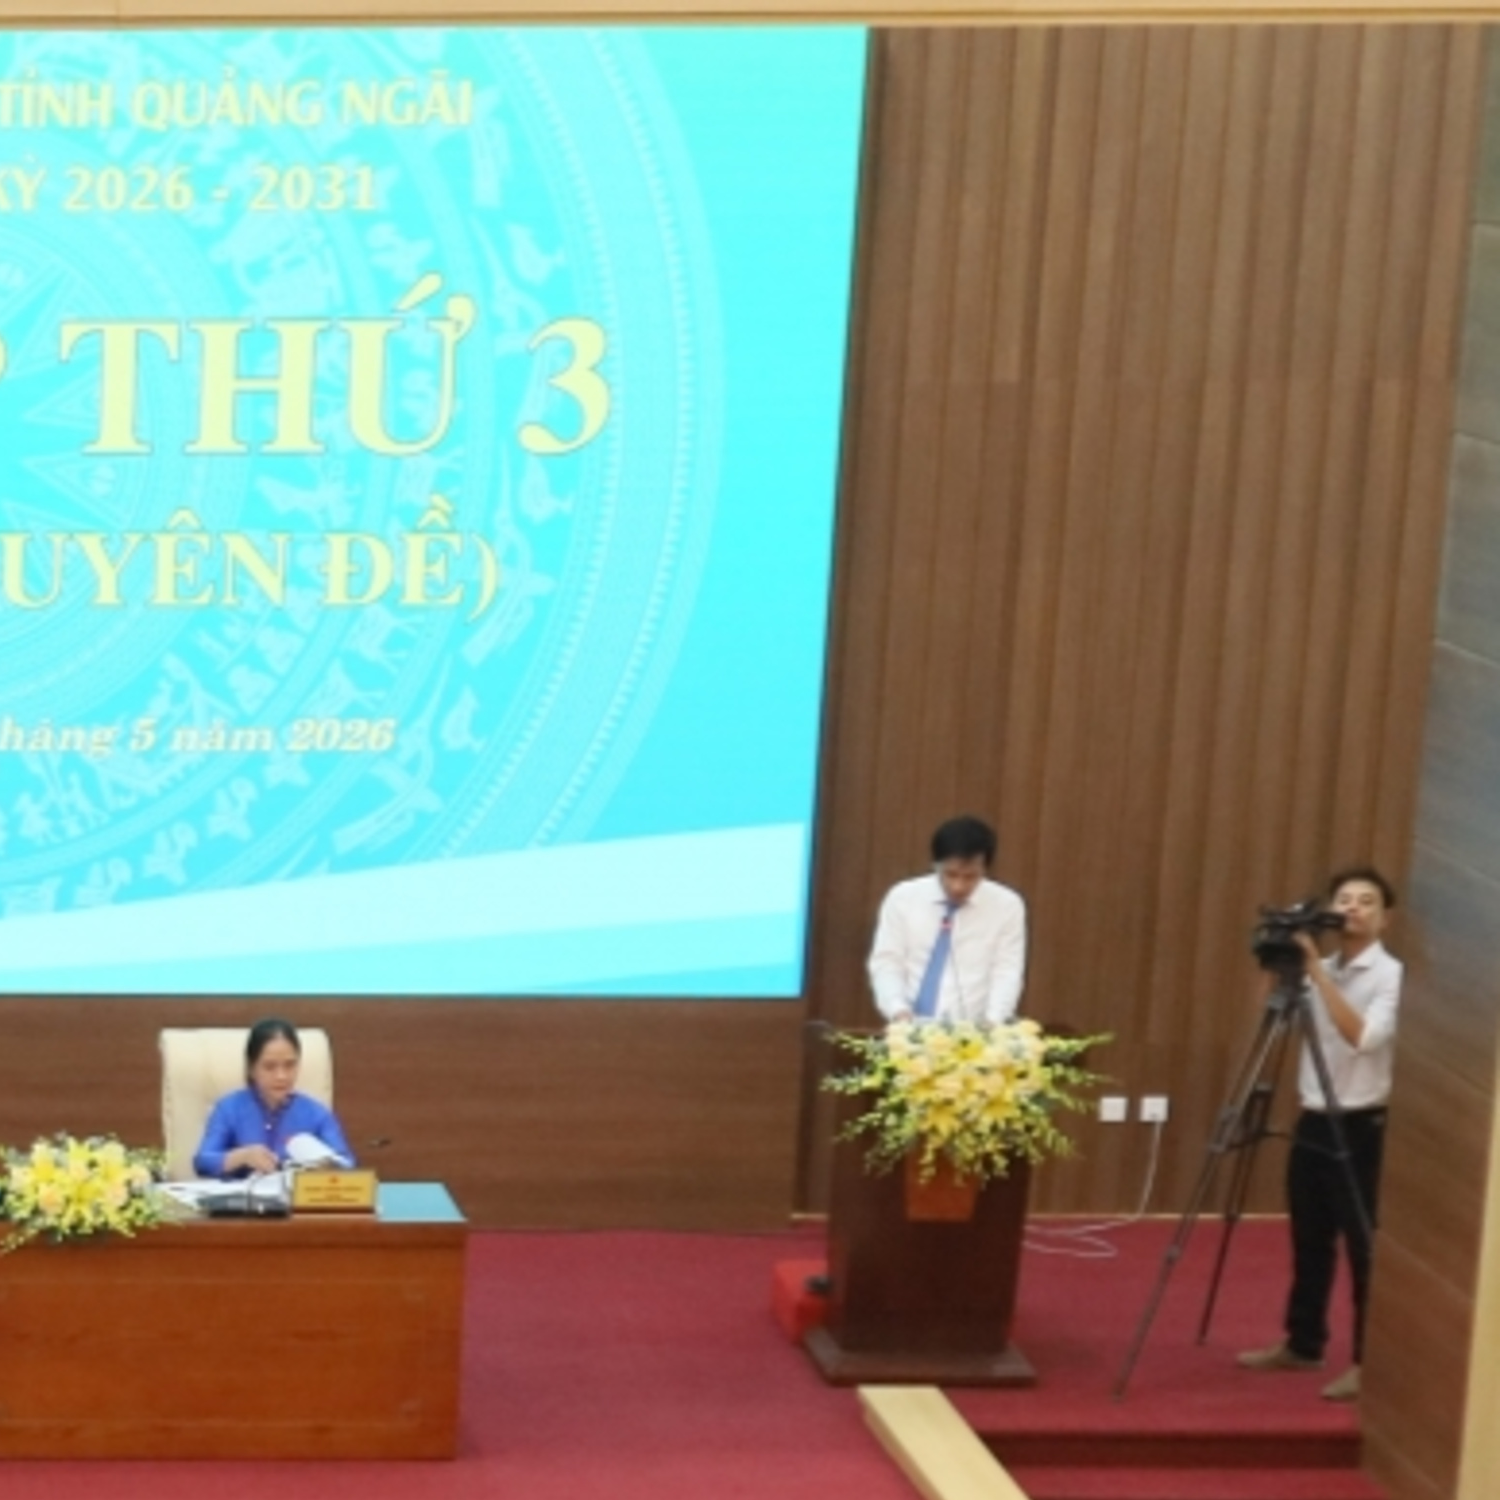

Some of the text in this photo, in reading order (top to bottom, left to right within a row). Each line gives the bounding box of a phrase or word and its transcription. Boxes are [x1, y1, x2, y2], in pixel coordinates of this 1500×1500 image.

[62, 162, 196, 214] 2026
[212, 185, 231, 201] -
[247, 161, 376, 214] 2031
[57, 271, 479, 458] THỨ
[516, 314, 614, 458] 3
[318, 493, 501, 625] ĐỀ)
[129, 715, 159, 752] 5
[286, 715, 397, 752] 2026
